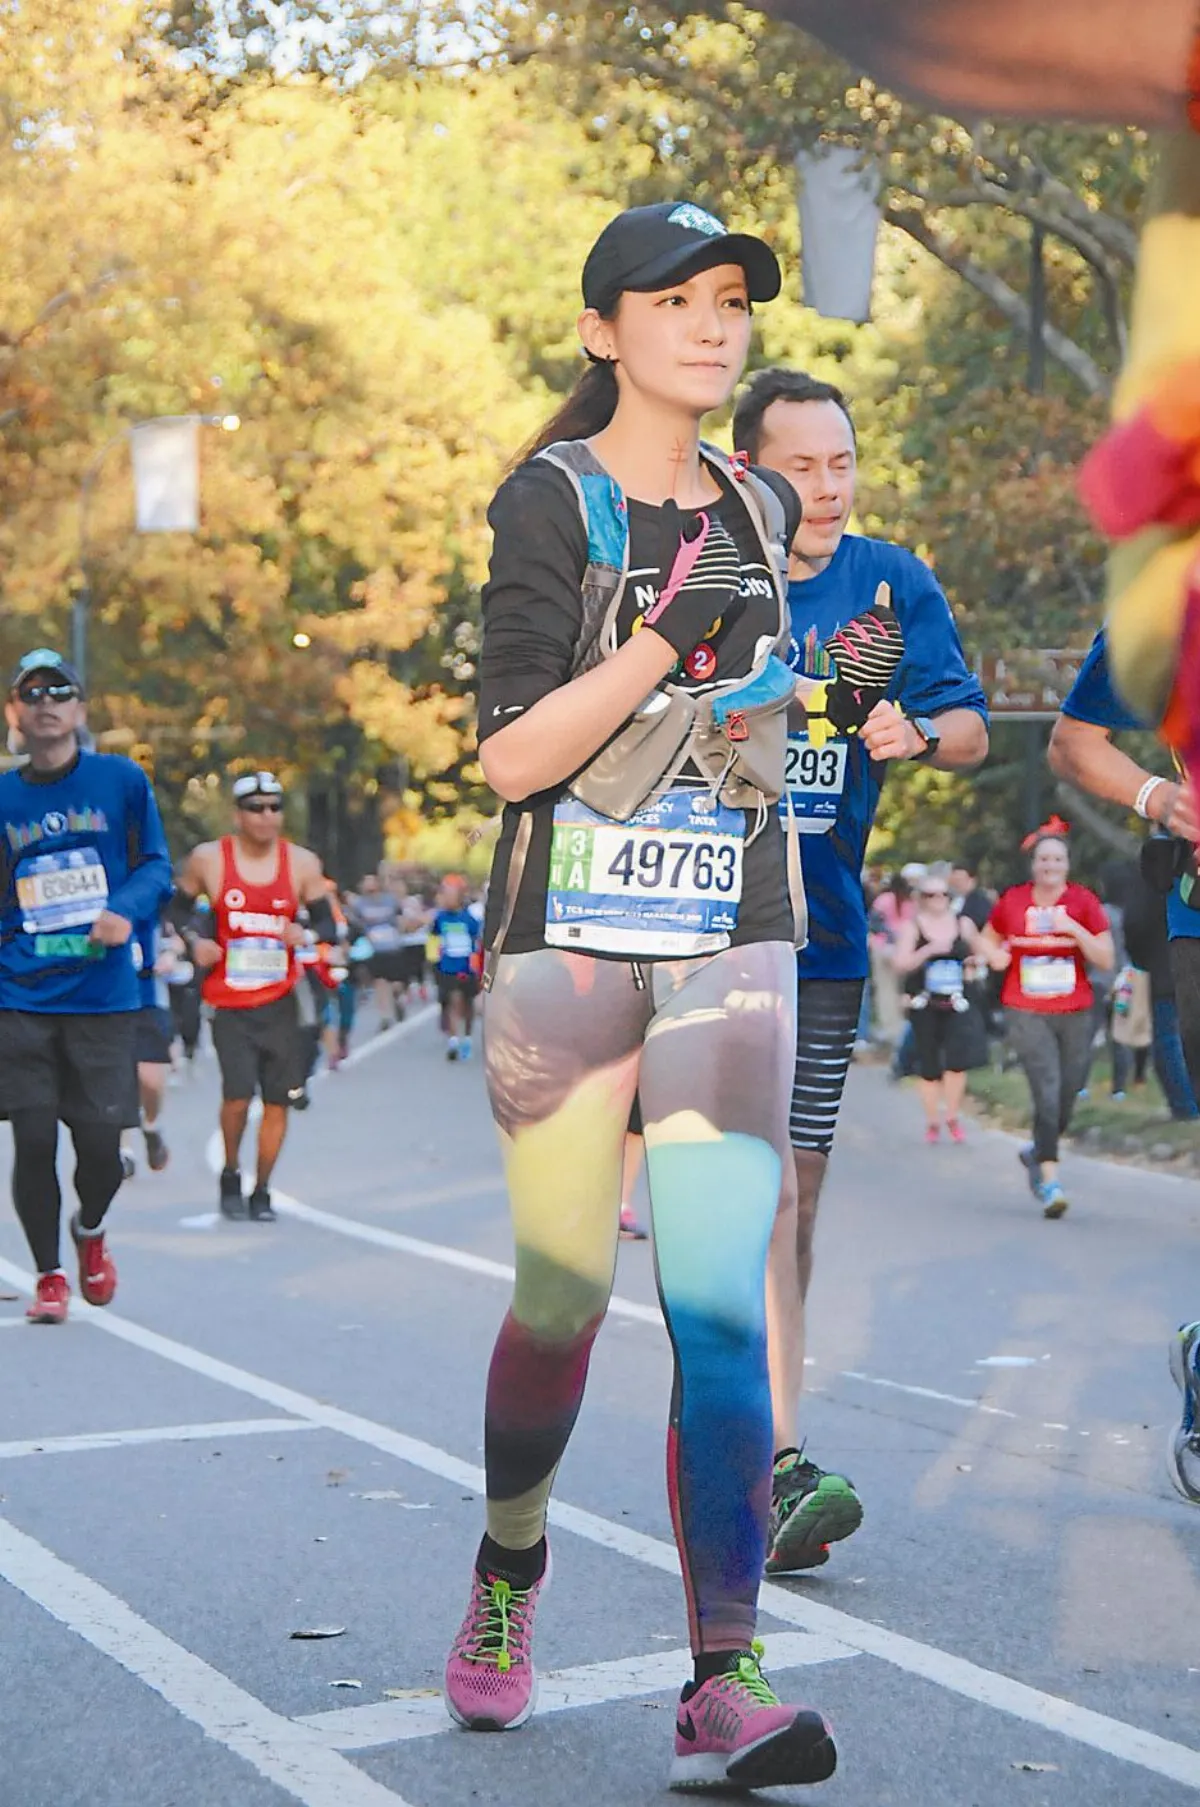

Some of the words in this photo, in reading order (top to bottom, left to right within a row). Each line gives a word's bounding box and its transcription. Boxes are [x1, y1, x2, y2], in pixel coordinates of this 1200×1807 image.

[694, 650, 708, 670] 2
[687, 814, 717, 826] TATA
[571, 830, 587, 856] 3
[567, 861, 584, 889] A
[607, 839, 737, 892] 49763
